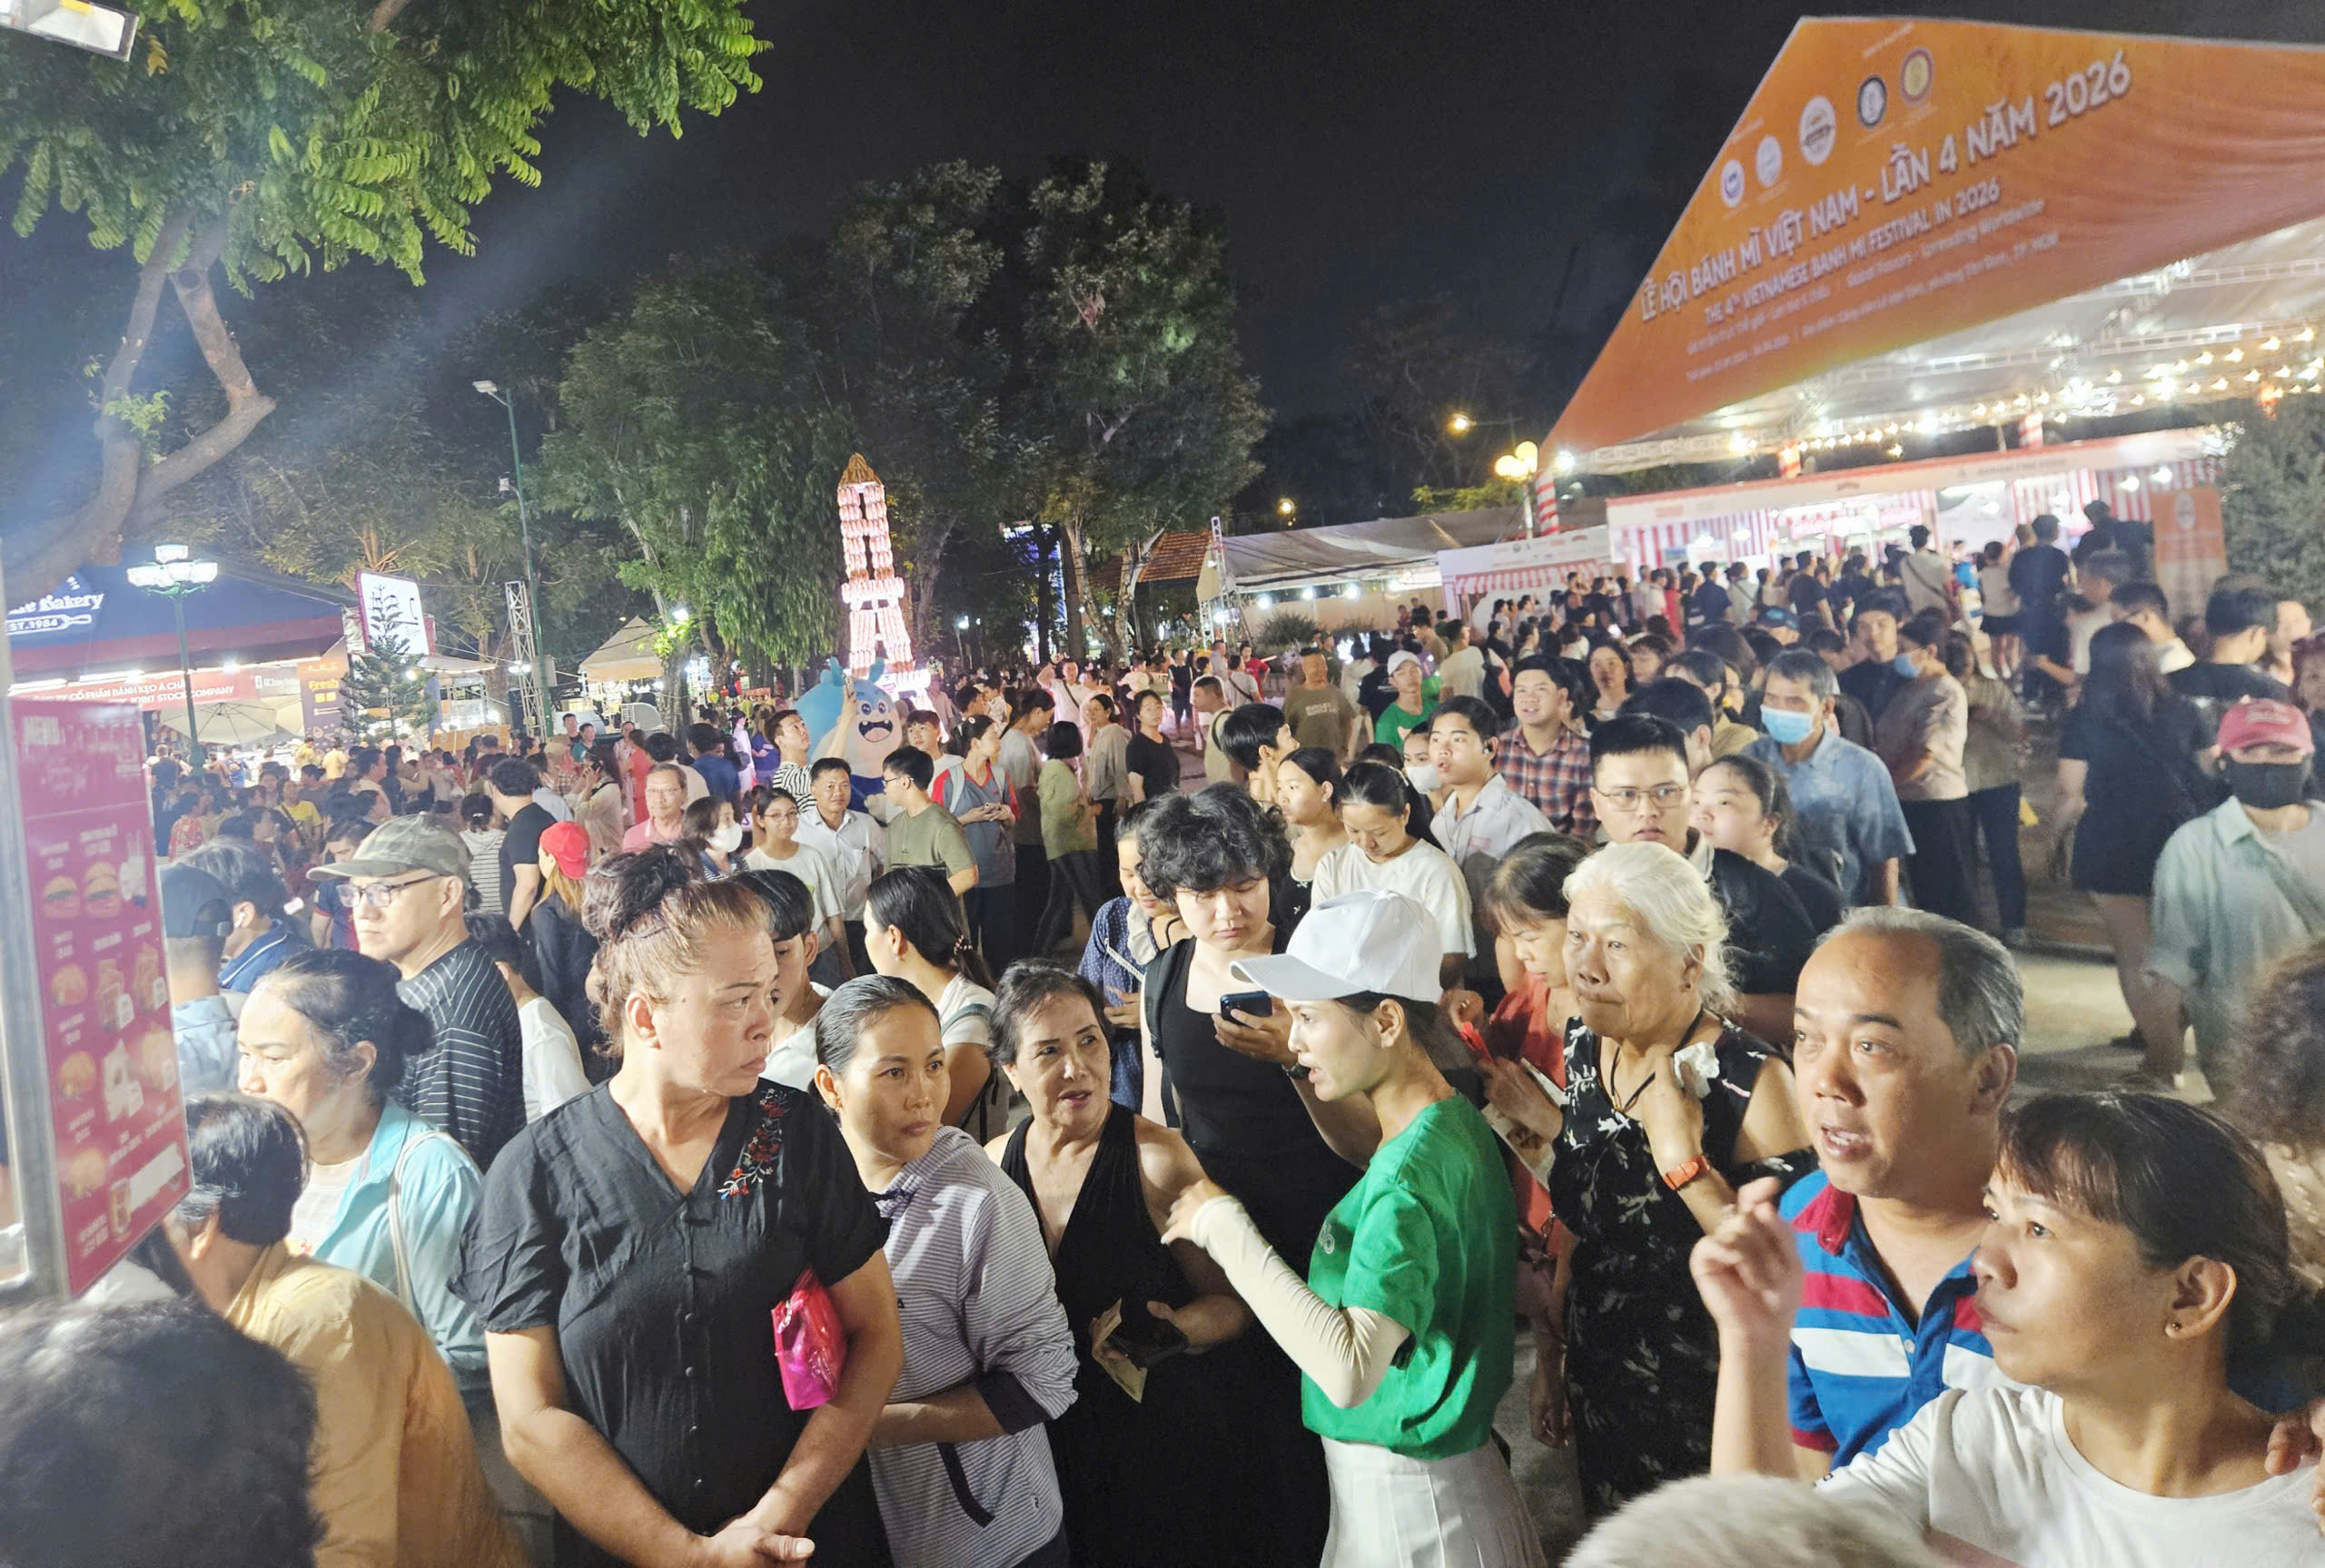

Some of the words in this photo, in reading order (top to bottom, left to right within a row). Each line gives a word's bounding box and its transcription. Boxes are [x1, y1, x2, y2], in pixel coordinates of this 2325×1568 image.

[1660, 271, 1688, 313] HỘI
[1690, 247, 1736, 298] BÁNH
[1764, 210, 1805, 258] VIỆT
[1809, 183, 1859, 239] NAM
[1939, 133, 1958, 174] 4
[1964, 94, 2037, 165] NĂM
[2045, 49, 2132, 129] 2026
[1705, 301, 1723, 324] THE
[1743, 261, 1810, 309] VIETNAMESE
[1811, 244, 1847, 279] BANH
[1849, 234, 1867, 260] MI
[1867, 208, 1932, 252] FESTIVAL
[1934, 196, 1953, 226] IN
[1954, 175, 2001, 218] 2026
[38, 594, 104, 611] Bakery
[5, 617, 59, 633] ST.1984
[112, 685, 136, 696] BÁNH
[137, 683, 157, 695] KẸO
[158, 689, 188, 704] STOCK
[191, 685, 234, 699] COMPANY
